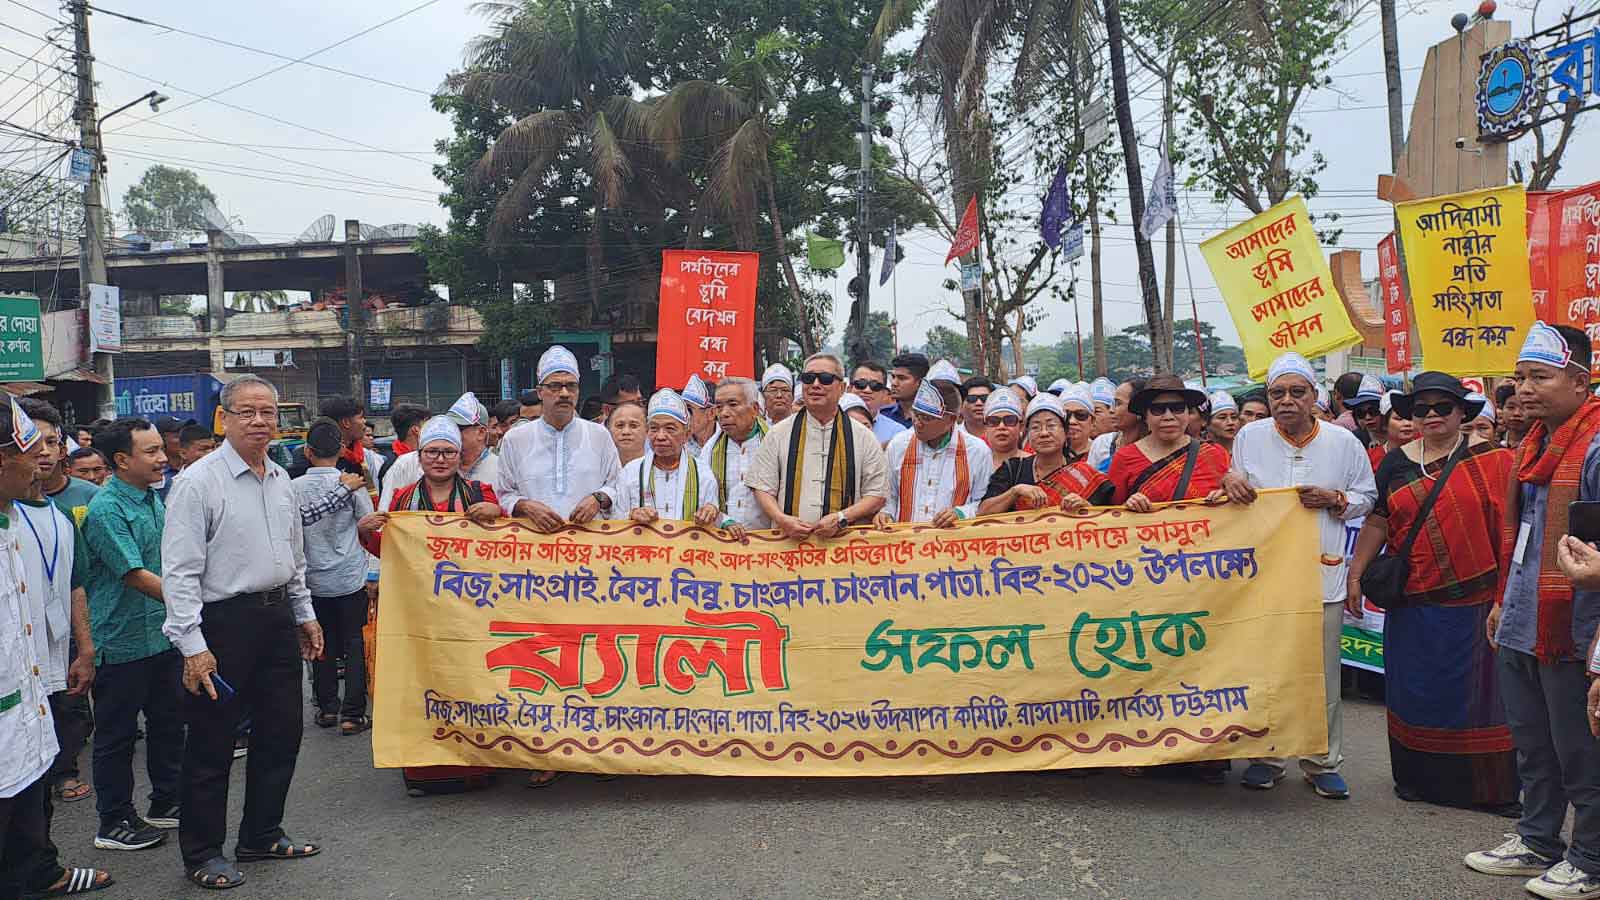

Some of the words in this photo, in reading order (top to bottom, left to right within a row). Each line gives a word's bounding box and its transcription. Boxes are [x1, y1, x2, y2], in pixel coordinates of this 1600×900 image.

[1416, 197, 1502, 237] আদিবাসী
[1225, 213, 1297, 259] আমাদের
[1443, 230, 1496, 256] নারীর
[1252, 249, 1294, 288] ভূমি
[1451, 257, 1491, 283] প্রতি
[699, 279, 728, 304] ভূমি
[1251, 276, 1325, 322] আমাদের
[1432, 286, 1503, 319] সহিংসতা
[686, 307, 738, 327] বেদখল
[1269, 313, 1324, 349] জীবন
[699, 336, 729, 352] বন্ধ
[1441, 327, 1476, 349] বন্ধ
[1478, 326, 1515, 347] কর
[703, 361, 731, 377] কর
[475, 534, 534, 563] জাতীয়
[537, 537, 592, 565] অস্তিত্ব
[596, 544, 674, 565] সংরক্ষণ
[680, 547, 719, 570] এবং
[831, 538, 915, 566] প্রতিরোধে
[919, 532, 1050, 562] ঐক্যবদ্ধভাবে
[1055, 521, 1129, 551] এগিয়ে
[1136, 518, 1211, 546] আসুন
[1138, 545, 1259, 584] উপলক্ষ্যে
[860, 618, 1046, 674] সফল
[1069, 610, 1210, 680] হোক
[1106, 687, 1164, 721] পার্বত্য
[1167, 681, 1249, 717] চট্টগ্রাম
